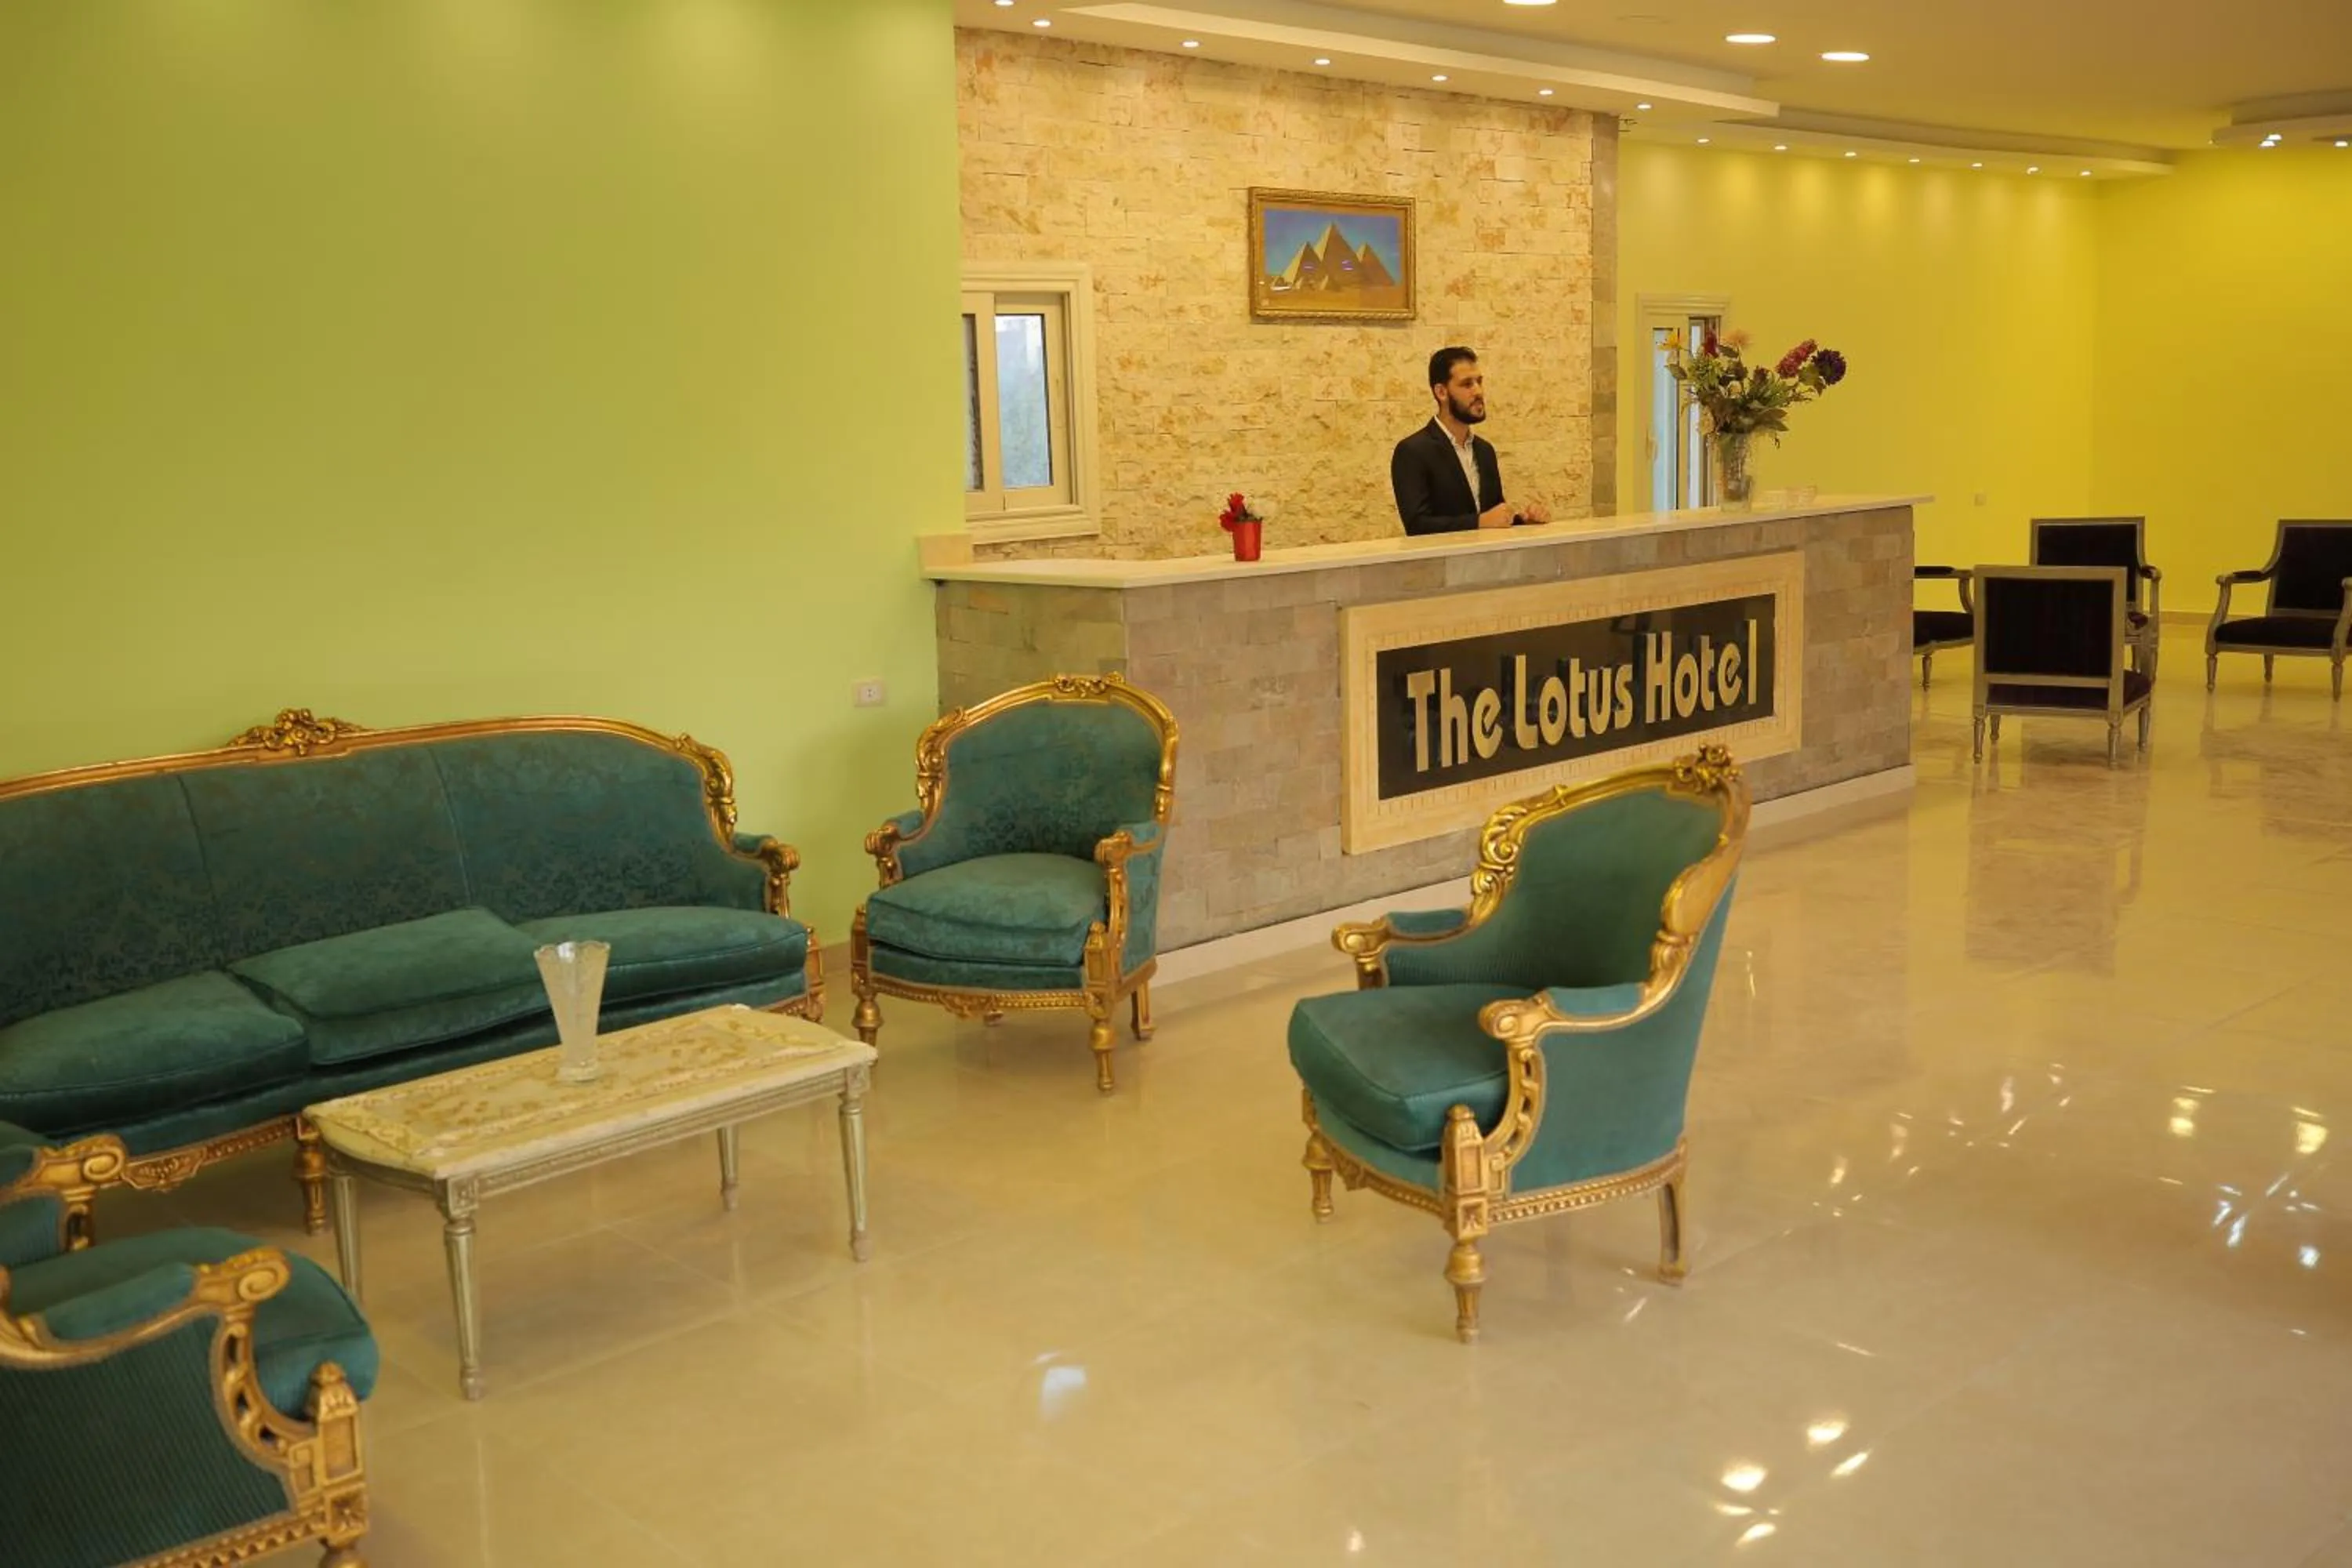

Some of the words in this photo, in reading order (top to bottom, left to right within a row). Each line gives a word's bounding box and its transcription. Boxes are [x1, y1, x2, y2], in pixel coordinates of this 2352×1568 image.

[1407, 668, 1503, 772] The
[1515, 655, 1633, 750] Lotus
[1646, 619, 1757, 723] Hotel
